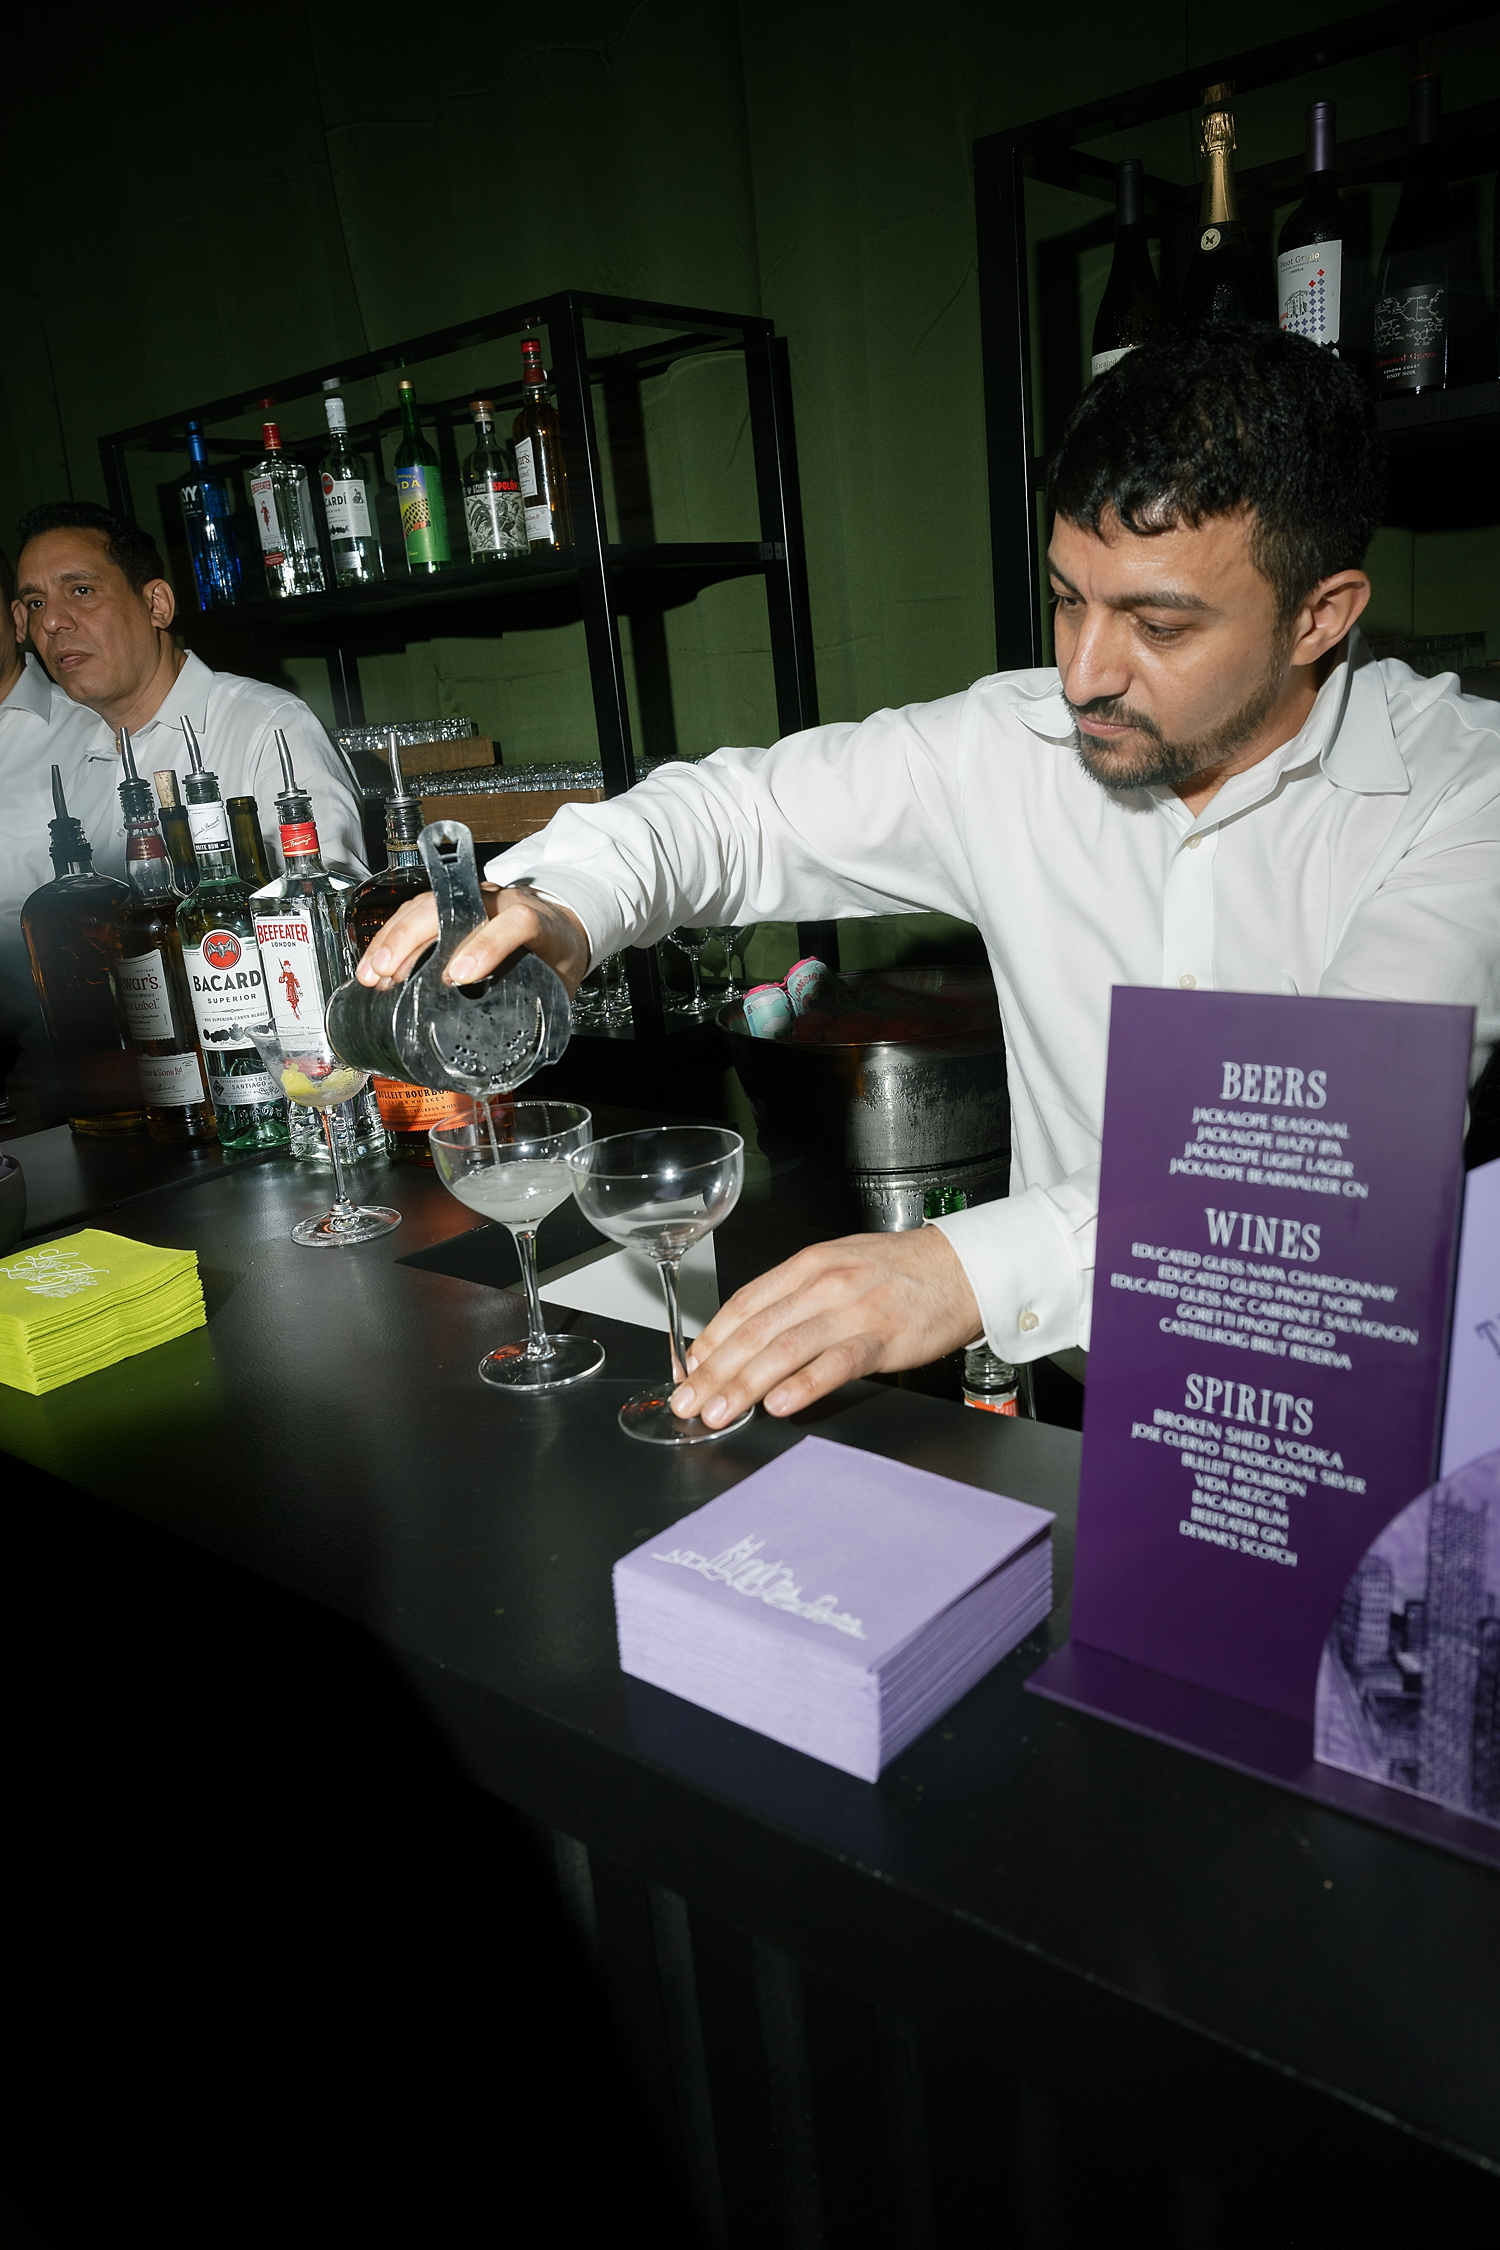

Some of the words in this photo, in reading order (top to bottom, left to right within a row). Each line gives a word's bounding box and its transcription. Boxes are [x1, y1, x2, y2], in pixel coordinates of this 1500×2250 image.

[181, 485, 198, 503] YY
[397, 479, 421, 491] IDA
[256, 923, 310, 945] BEEFEATER
[193, 970, 262, 992] BACARD
[207, 993, 257, 1004] SUPERIOR
[231, 1080, 267, 1090] SANTIAGO
[404, 1089, 453, 1099] BOURBO
[1219, 1062, 1326, 1109] BEERS
[411, 1096, 445, 1105] WHISKEY
[1319, 1140, 1342, 1156] IPA
[1342, 1181, 1368, 1198] ON
[1204, 1208, 1320, 1262] WINES
[1275, 1286, 1320, 1306] PINOT
[1322, 1295, 1362, 1315] NOIR
[1237, 1315, 1279, 1336] PINOT
[1247, 1299, 1320, 1325] CABERNET
[1323, 1313, 1418, 1344] SAUVIGNON
[1250, 1336, 1287, 1356] BRUT
[1184, 1374, 1313, 1435] SPIRITS
[1152, 1409, 1222, 1439] BROKEN
[1225, 1426, 1270, 1450] SHED
[1274, 1438, 1343, 1470] VODKA
[1163, 1431, 1220, 1456] CUERVO
[1194, 1473, 1229, 1494] VIDA
[1233, 1465, 1306, 1496] BOURBON
[1191, 1489, 1254, 1518] BACARDI
[1255, 1507, 1289, 1528] RUM
[1260, 1527, 1288, 1546] GIN
[1240, 1538, 1297, 1566] SCOTCH
